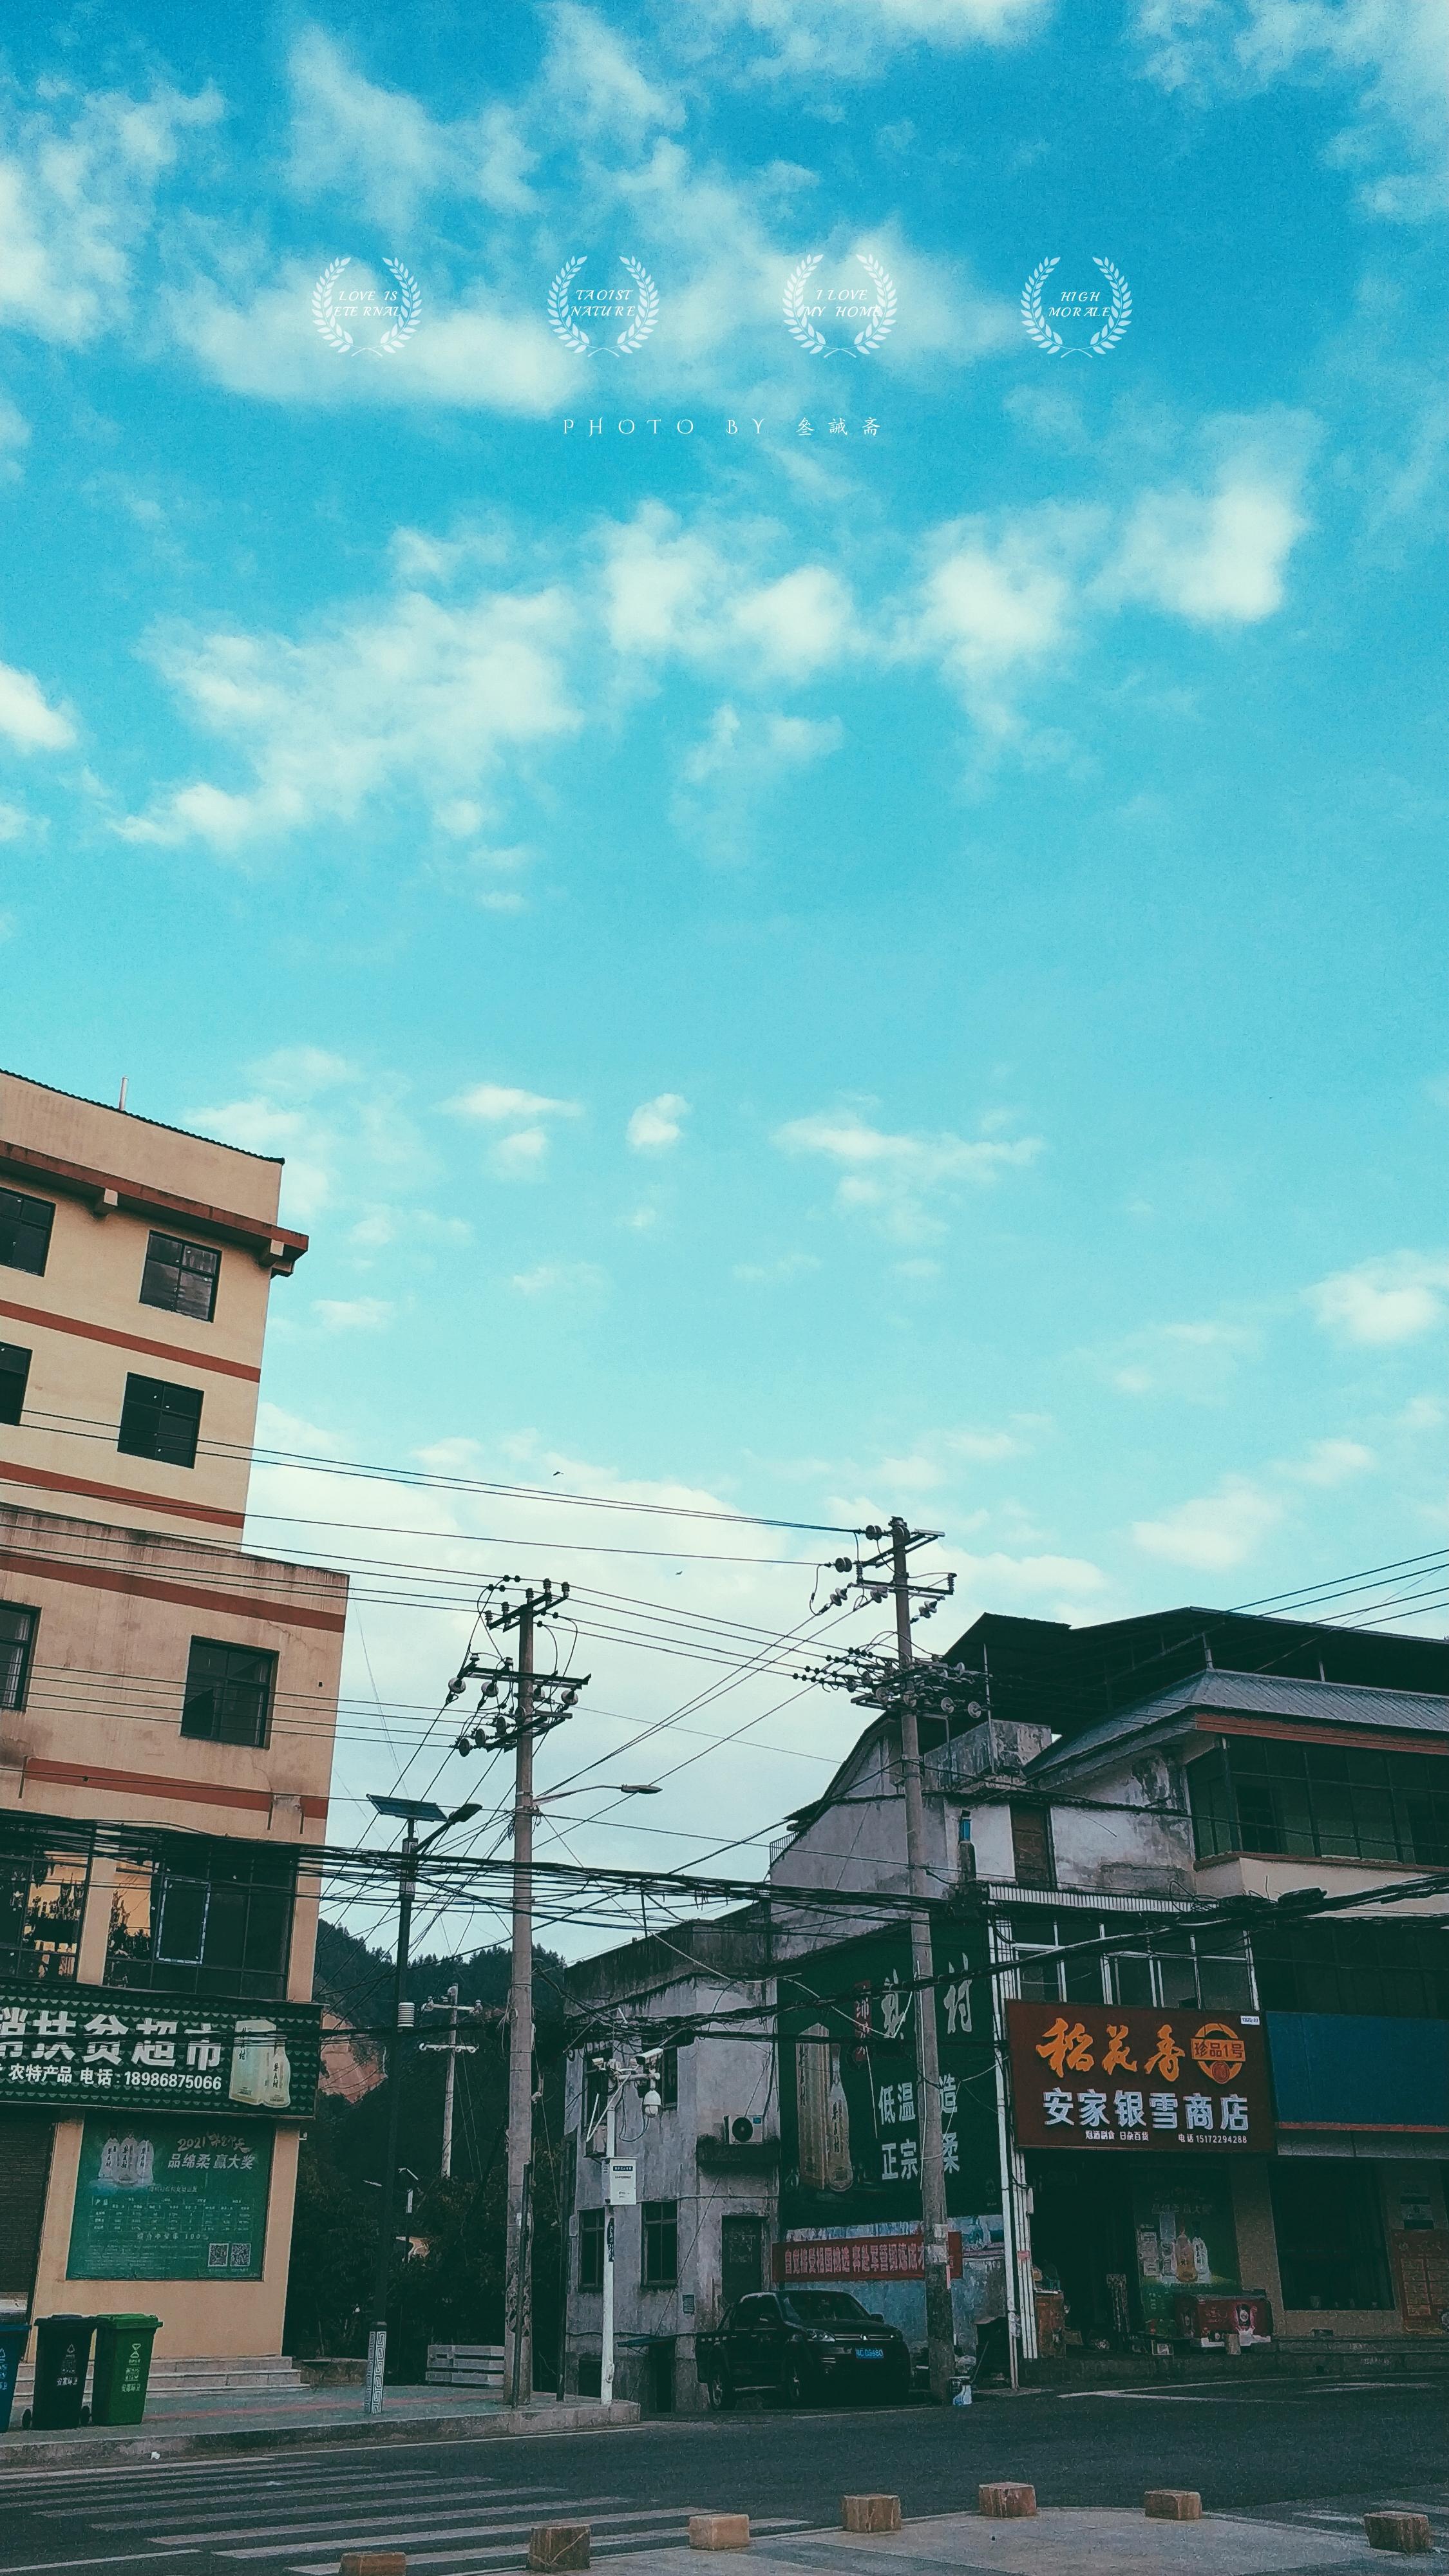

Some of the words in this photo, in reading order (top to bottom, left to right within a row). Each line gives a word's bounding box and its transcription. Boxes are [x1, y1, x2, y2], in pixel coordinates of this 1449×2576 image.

[1035, 2017, 1186, 2082] 稻花香
[1194, 2043, 1244, 2059] 珍品1号
[8, 2063, 73, 2084] 农特产品
[878, 2072, 958, 2125] 低温造
[1043, 2087, 1249, 2131] 安家银雪商店
[1119, 2131, 1150, 2141] 日杂百货
[1178, 2134, 1194, 2143] 电话
[1196, 2134, 1247, 2144] 15172294288
[167, 2153, 211, 2169] 品绵柔
[213, 2154, 256, 2170] 赢大奖
[881, 2132, 960, 2180] 正宗柔
